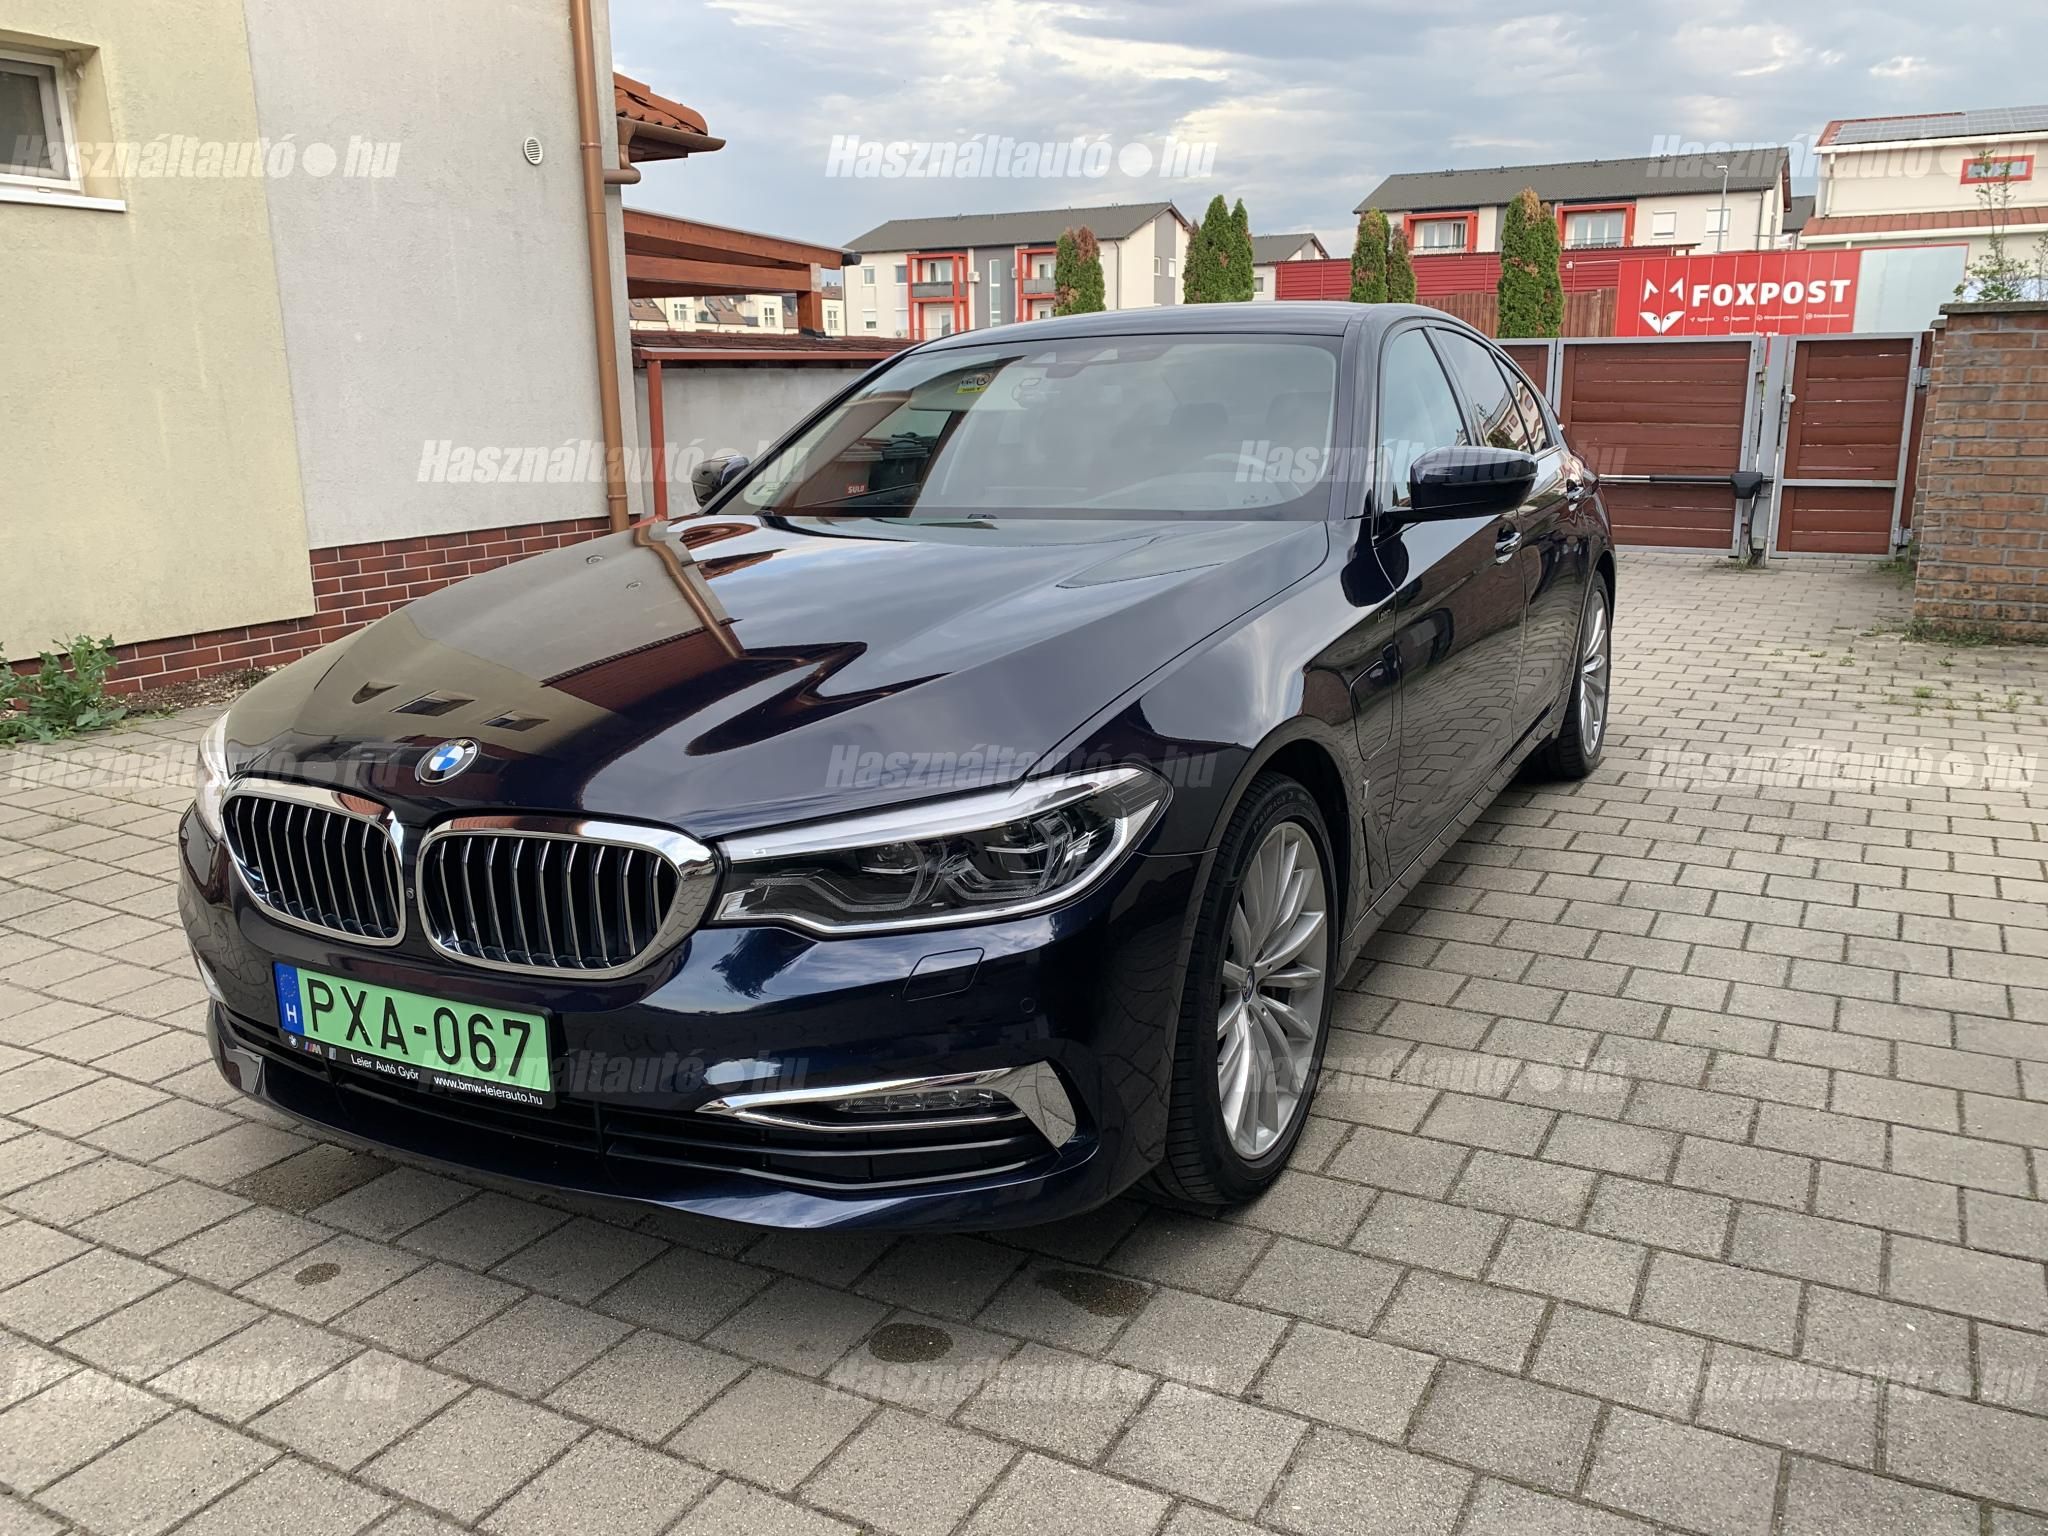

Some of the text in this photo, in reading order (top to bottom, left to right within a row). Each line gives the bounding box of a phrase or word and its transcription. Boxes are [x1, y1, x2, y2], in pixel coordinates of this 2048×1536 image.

[1692, 279, 1851, 307] FOXPOST
[285, 1002, 298, 1024] H
[306, 977, 531, 1077] PXA-067
[350, 1053, 372, 1069] Leier
[376, 1060, 396, 1075] Autó
[433, 1075, 543, 1105] www.bmw-leierauto.hu
